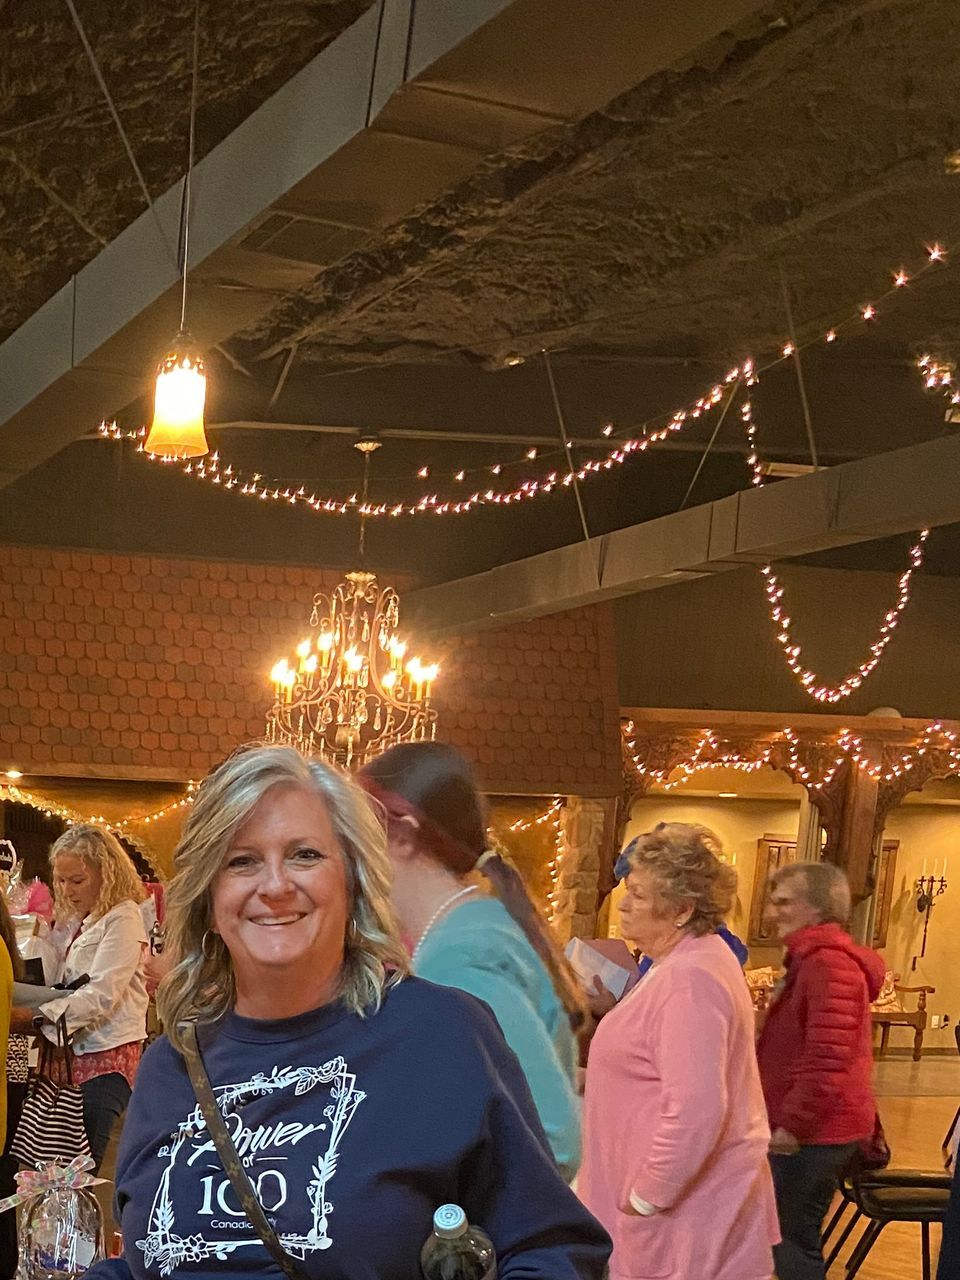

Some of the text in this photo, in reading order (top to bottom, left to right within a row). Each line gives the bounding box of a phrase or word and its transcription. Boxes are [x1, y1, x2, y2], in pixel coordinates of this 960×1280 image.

[187, 1112, 327, 1167] Power
[242, 1152, 257, 1169] of
[197, 1169, 287, 1217] 100
[210, 1219, 254, 1230] Canadia
